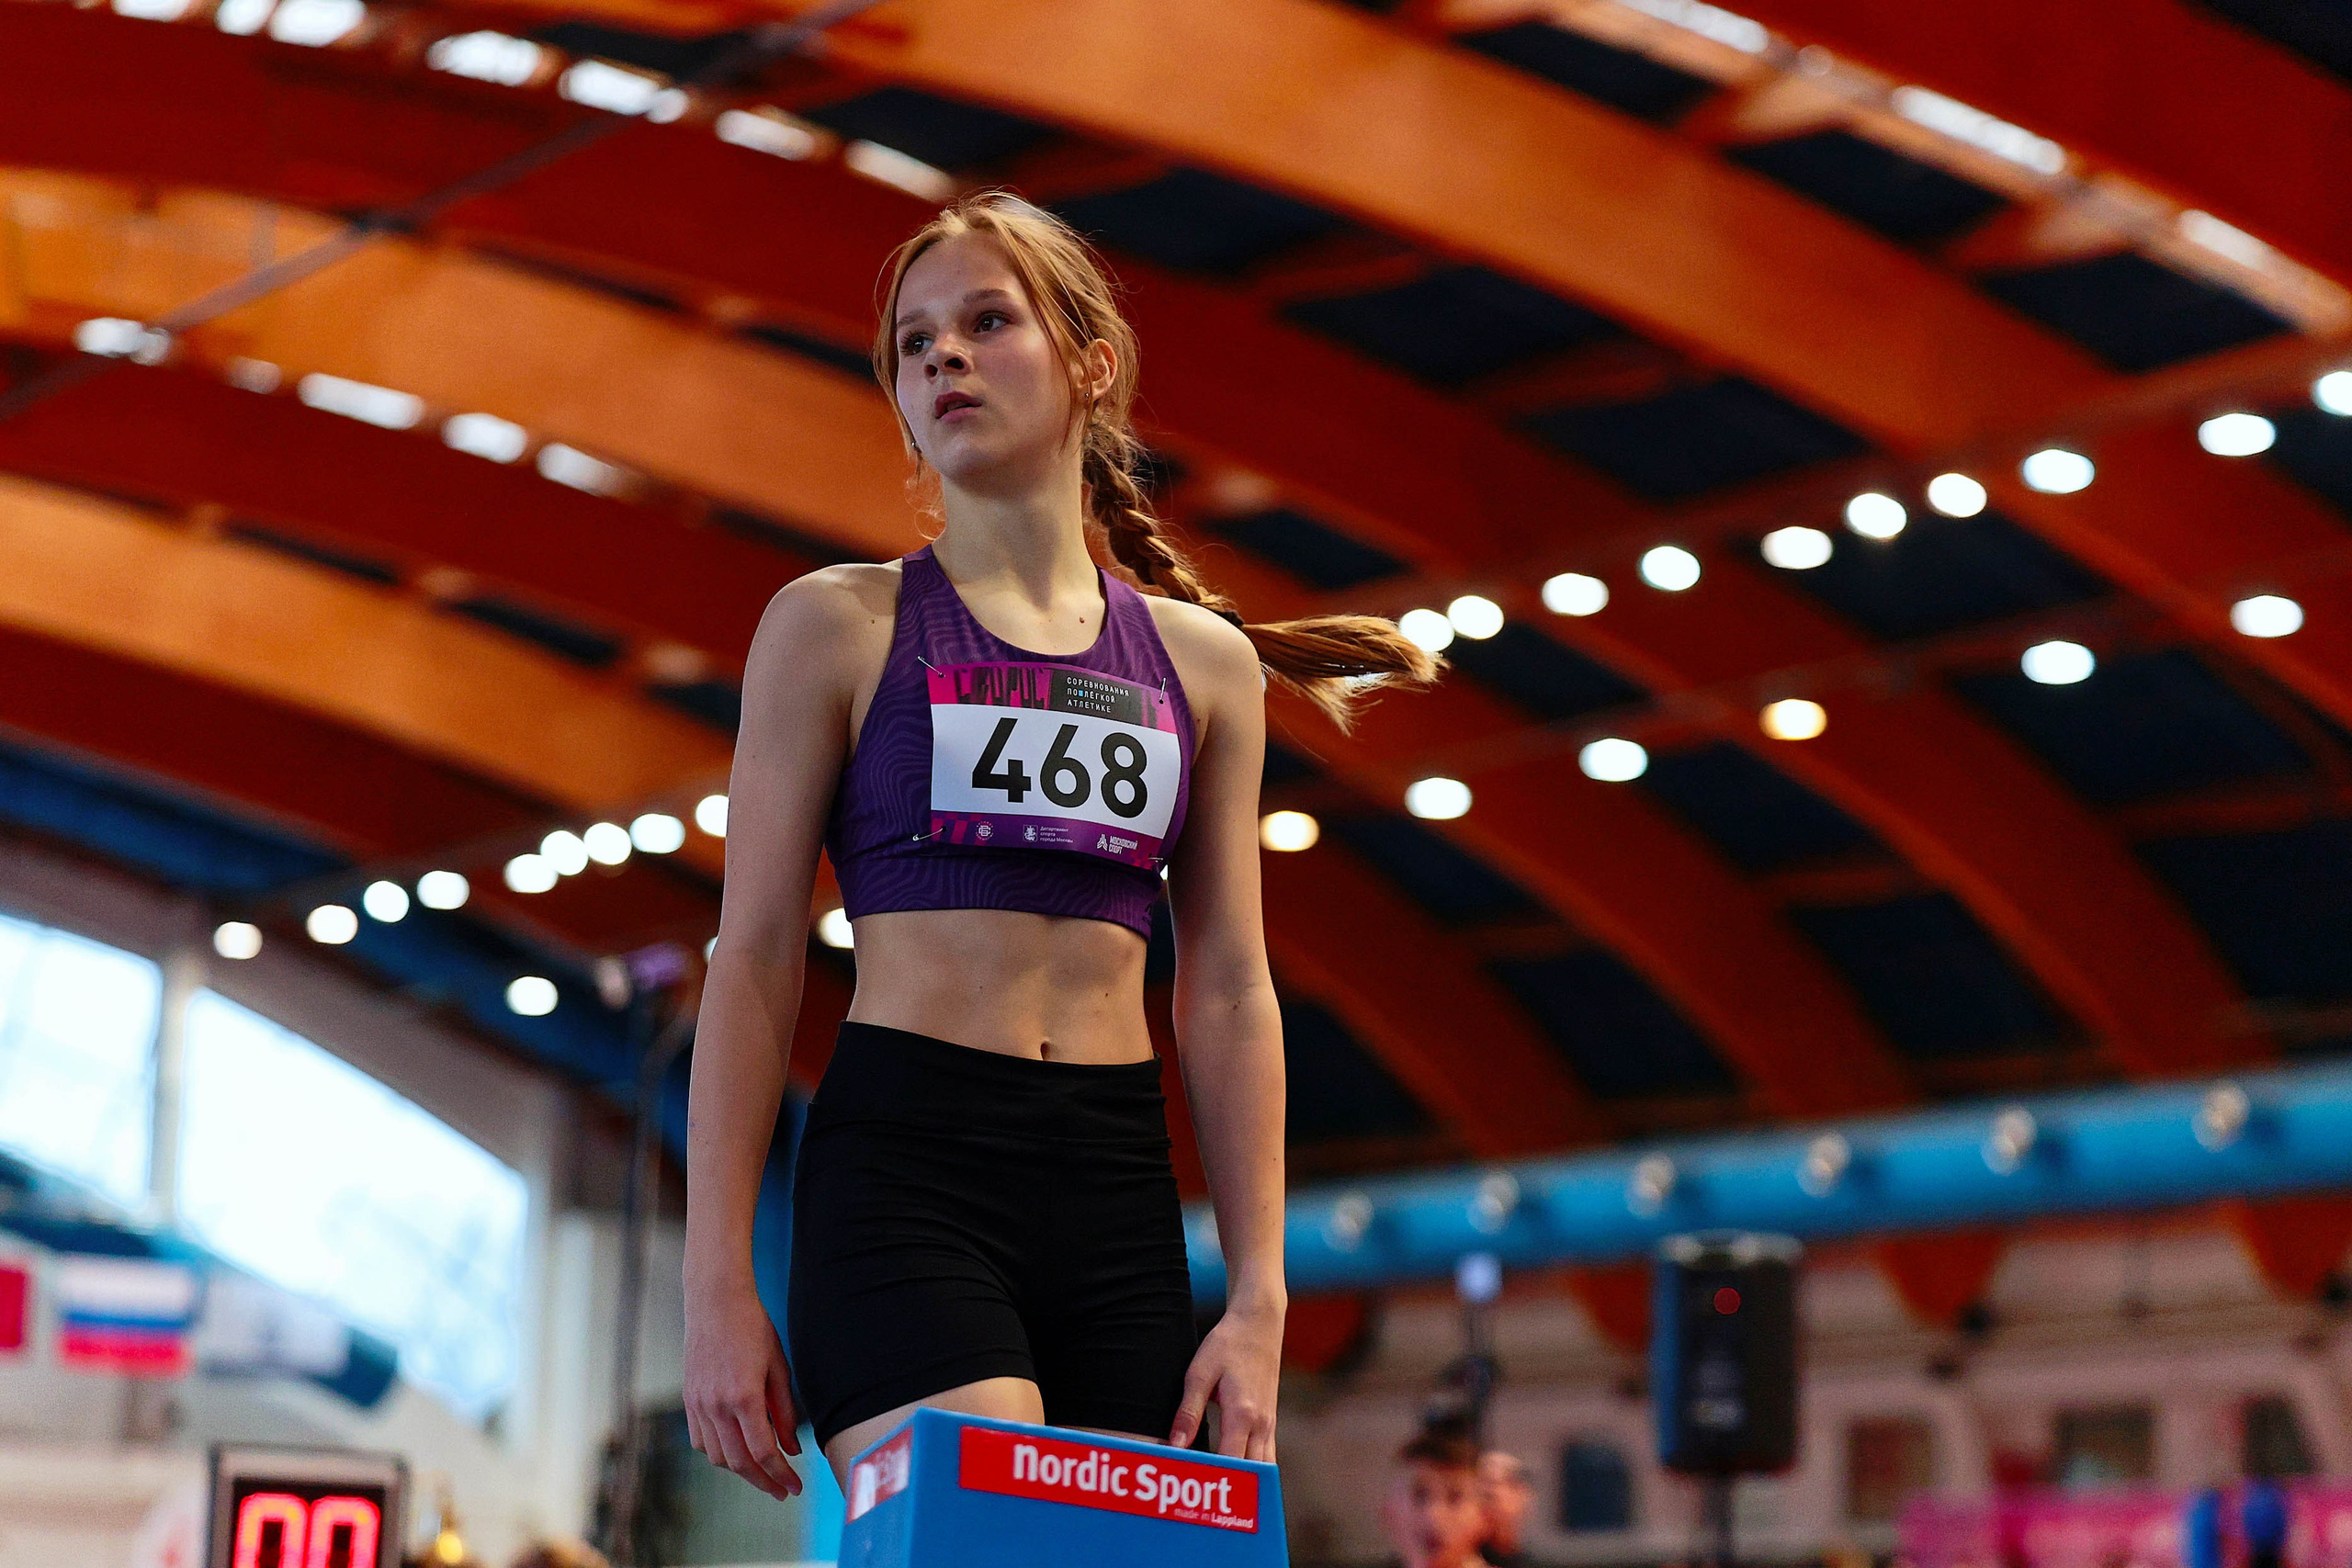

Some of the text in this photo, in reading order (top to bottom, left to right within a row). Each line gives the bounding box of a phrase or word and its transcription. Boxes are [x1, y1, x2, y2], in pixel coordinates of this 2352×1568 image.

[1067, 677, 1130, 696] СОРЕВНОВАНИЯ
[1067, 699, 1112, 713] АТЛЕТИКЕ
[972, 717, 1148, 818] 468
[1134, 1463, 1232, 1514] Sport
[1211, 1512, 1254, 1529] Lappland
